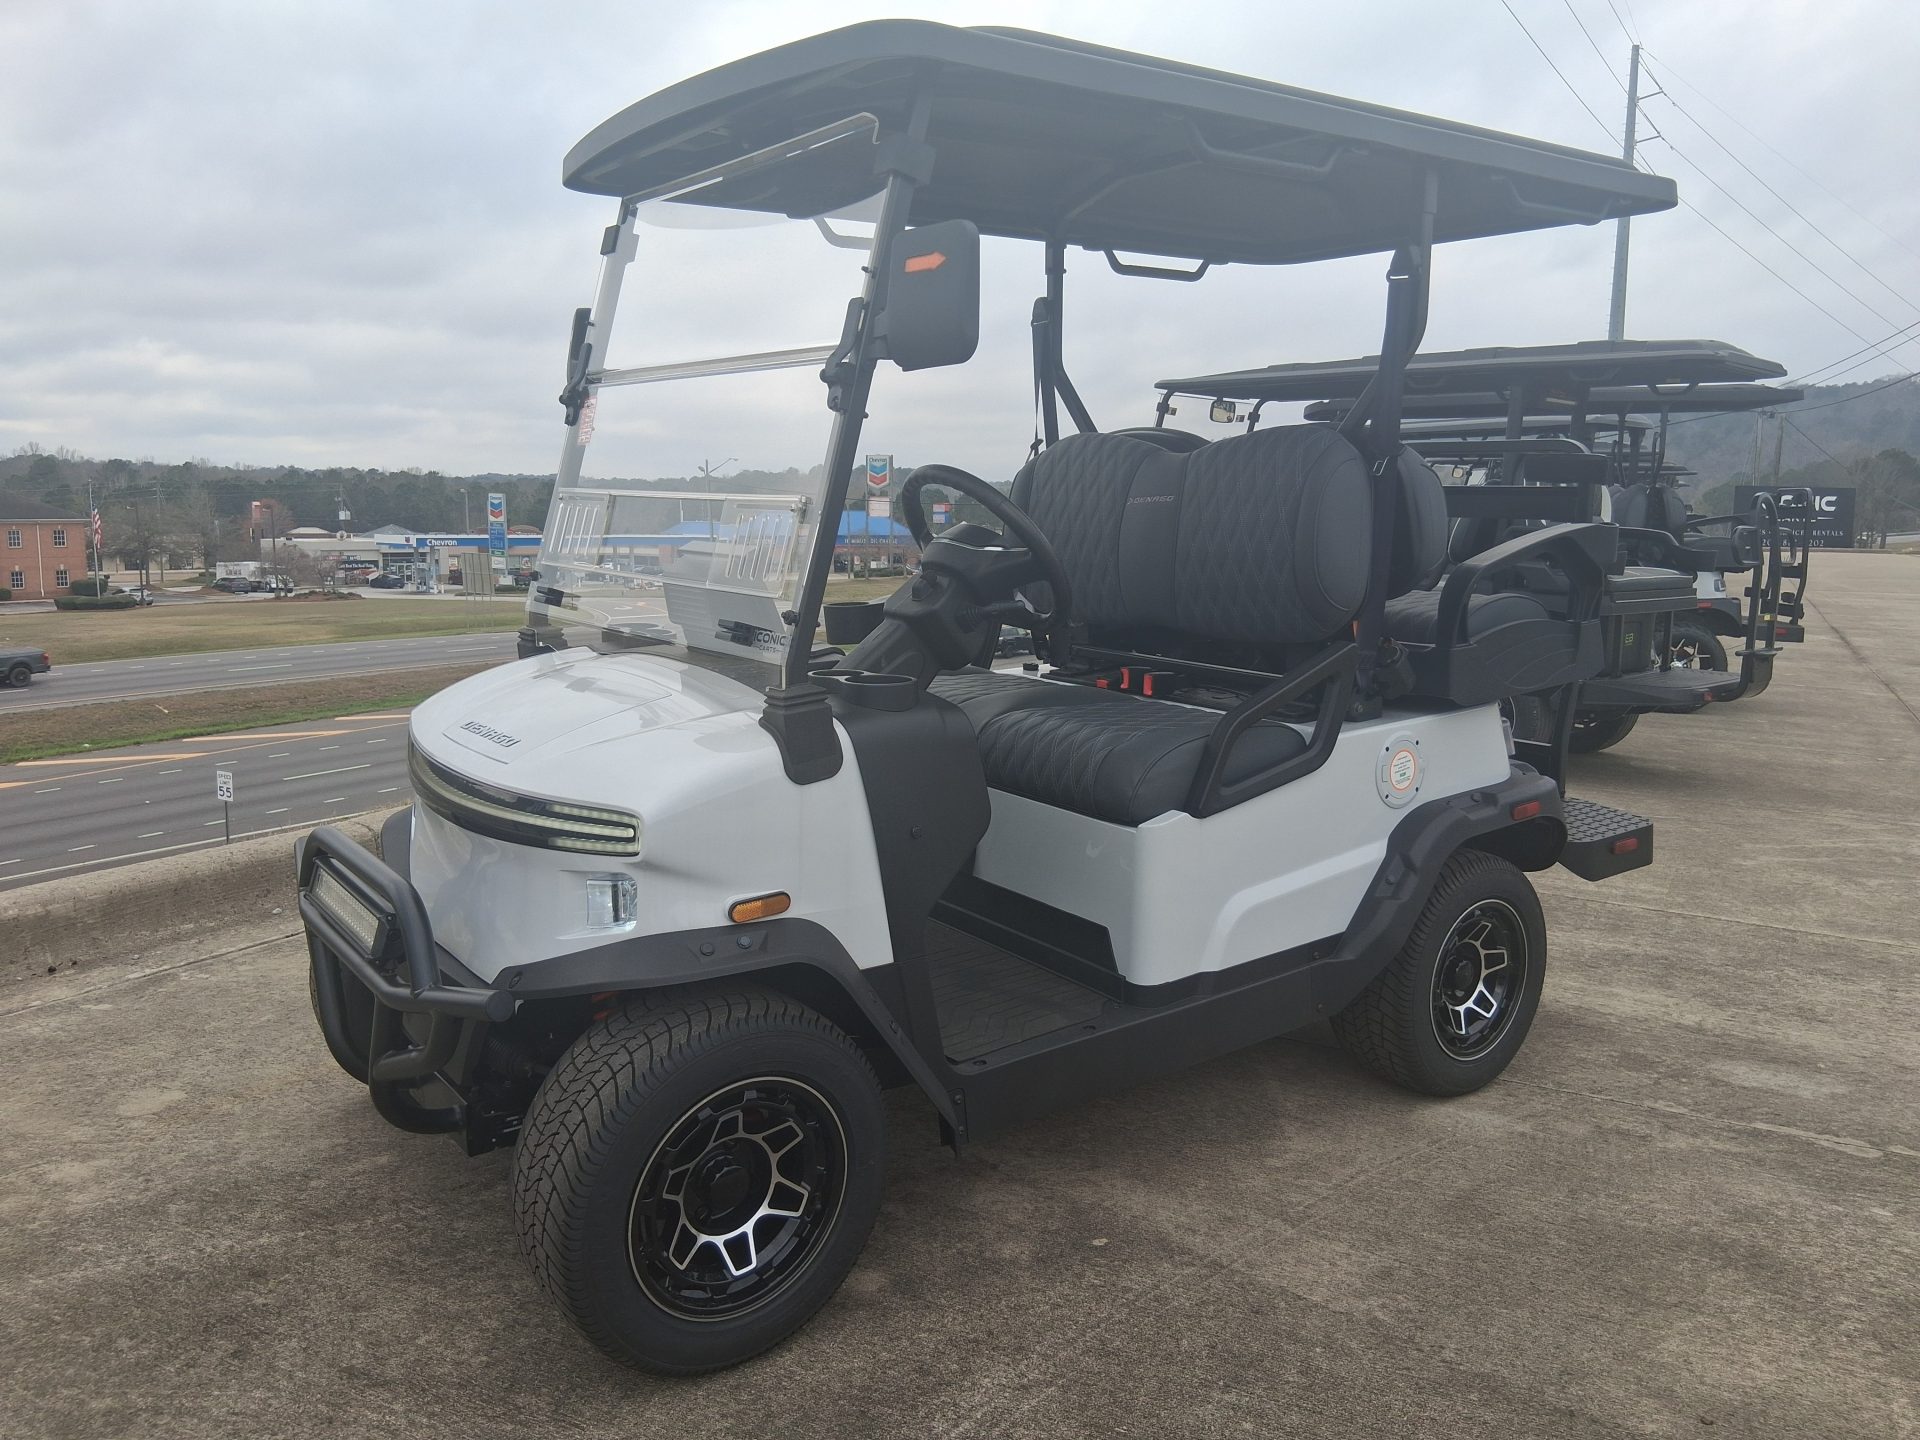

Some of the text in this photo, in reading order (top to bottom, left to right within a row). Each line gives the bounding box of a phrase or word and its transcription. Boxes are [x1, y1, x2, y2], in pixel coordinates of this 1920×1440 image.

[426, 538, 458, 546] Chevron
[753, 631, 786, 646] ICONIC
[460, 721, 521, 748] DENAGO
[219, 785, 232, 798] 55
